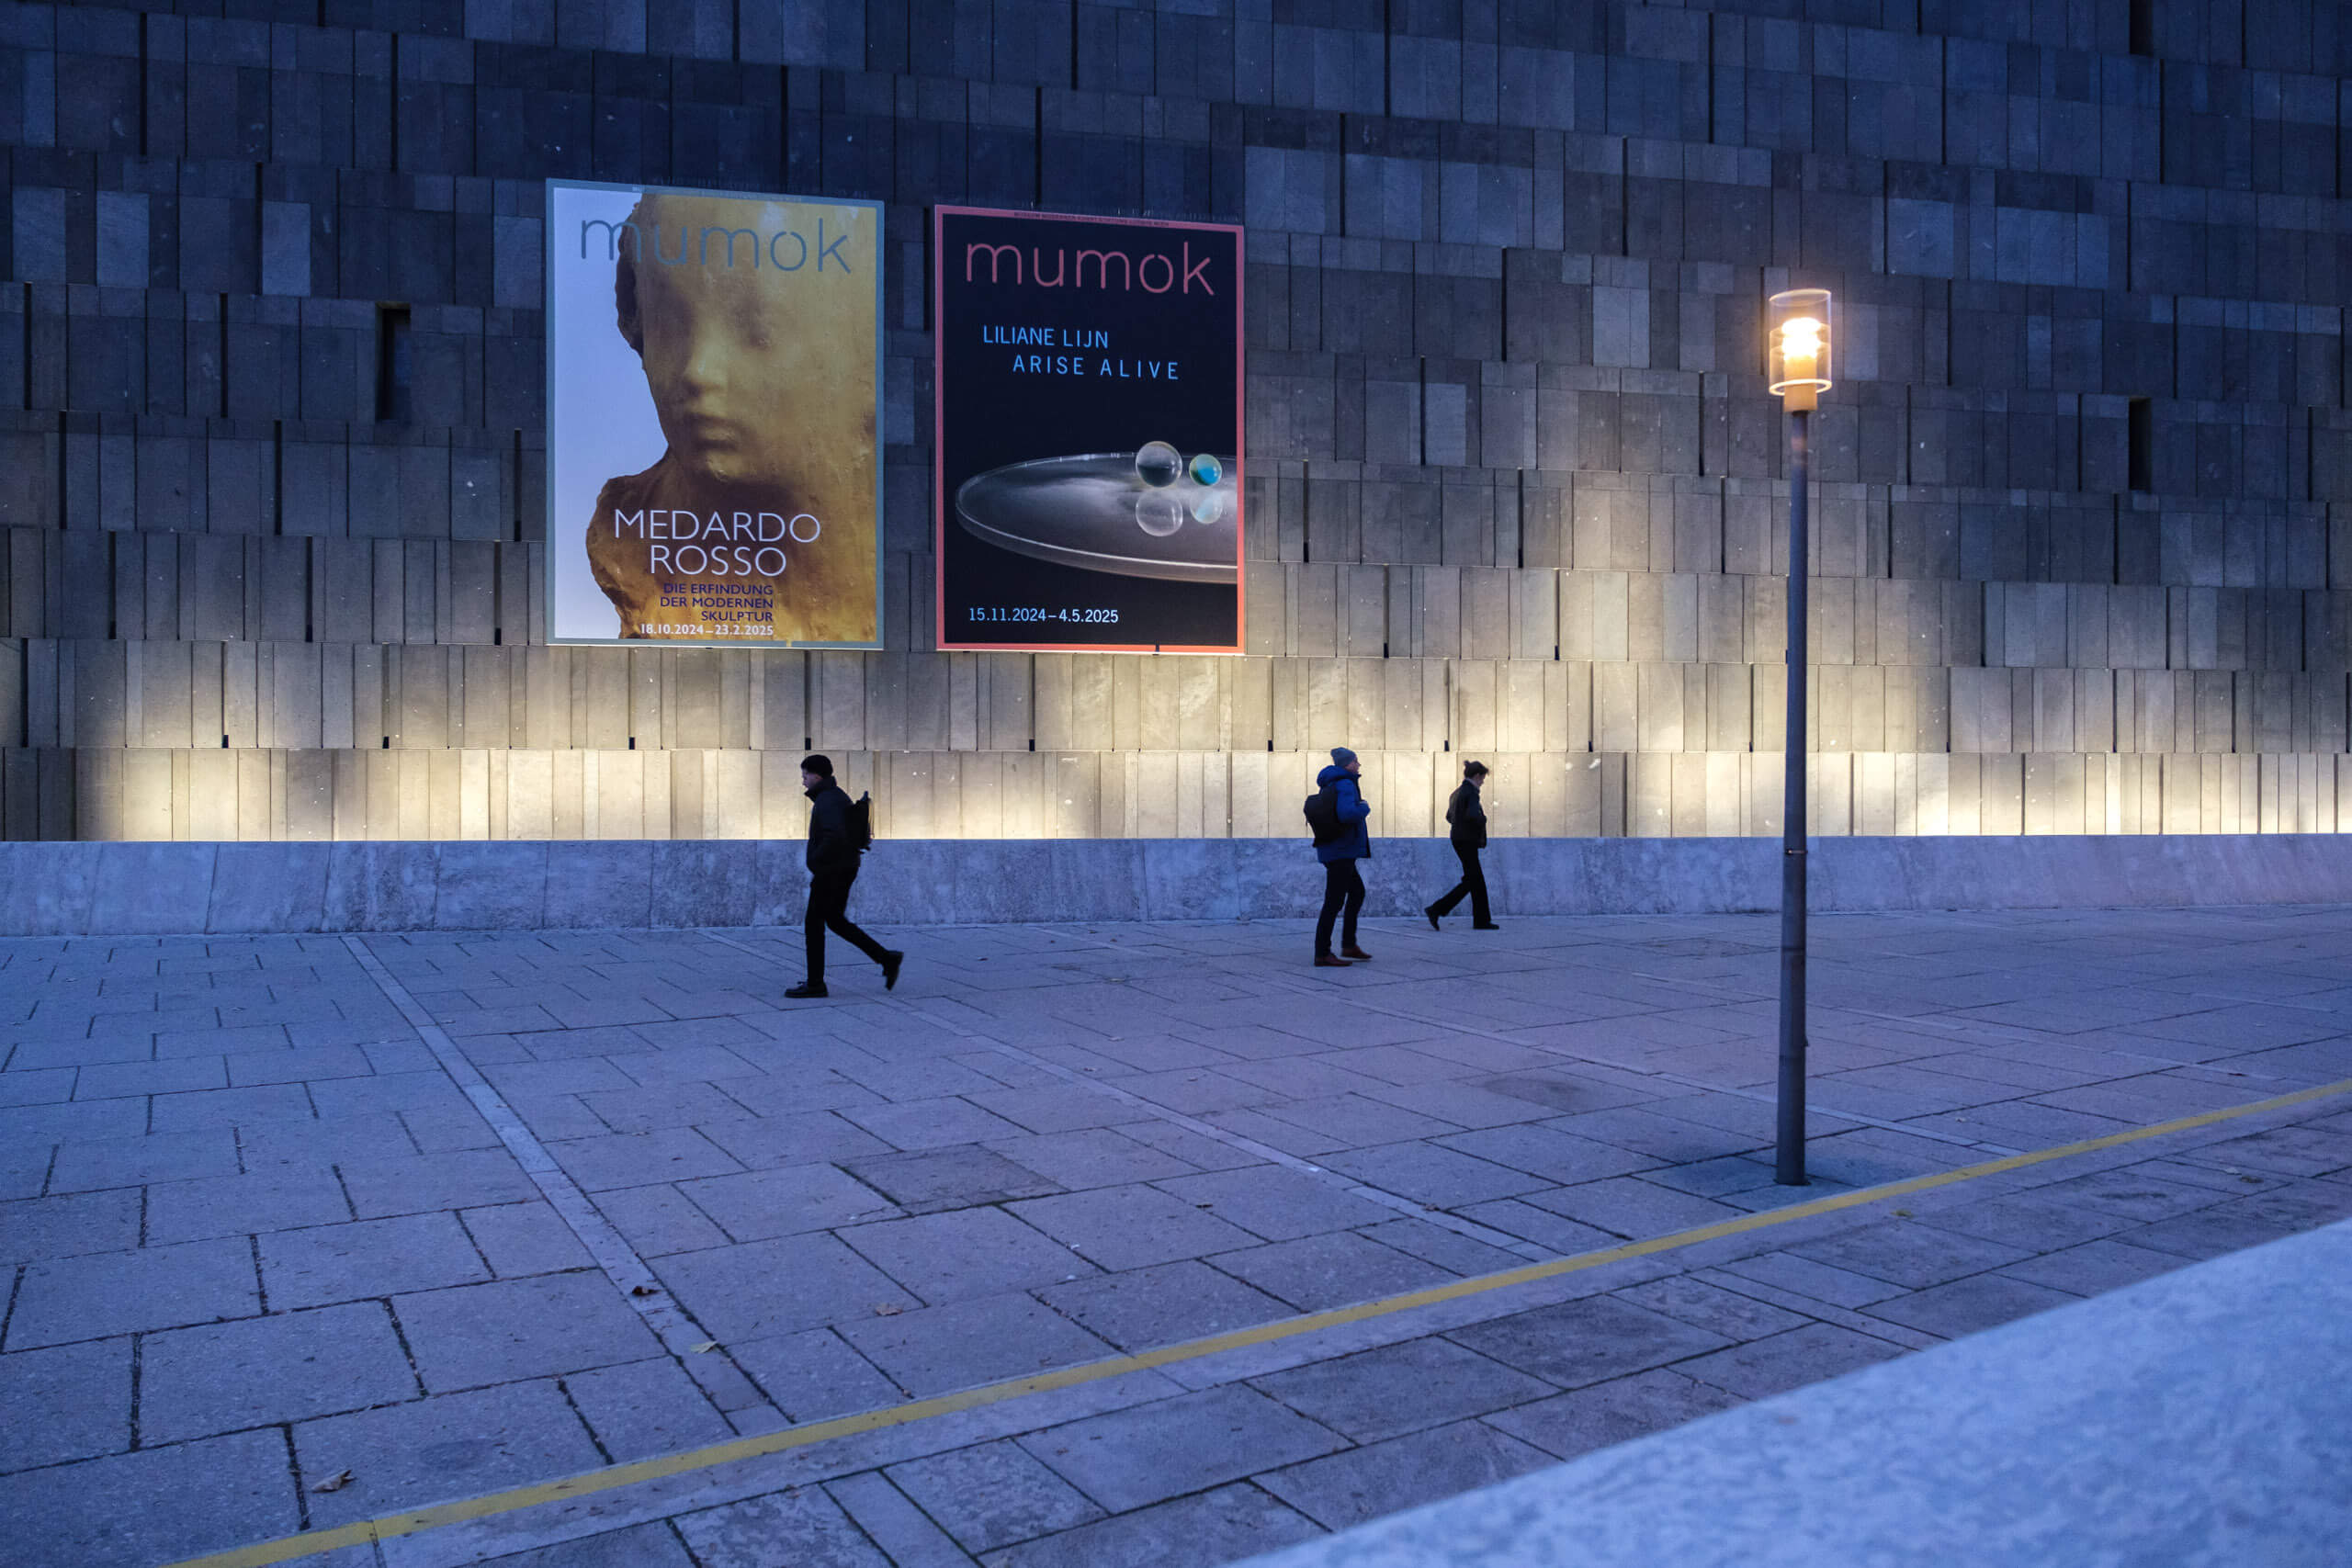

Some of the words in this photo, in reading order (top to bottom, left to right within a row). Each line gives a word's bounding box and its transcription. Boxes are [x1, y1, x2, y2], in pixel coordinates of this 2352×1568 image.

[581, 218, 852, 274] mumok
[966, 241, 1215, 296] mumok
[983, 324, 1056, 346] LILIANE
[1063, 328, 1109, 349] LIJN
[1012, 355, 1084, 376] ARISE
[1100, 358, 1179, 380] ALIVE
[614, 509, 821, 543] MEDARDO
[650, 545, 786, 577] ROSSO
[663, 582, 687, 594] DIE
[690, 583, 774, 595] ERFINDUNG
[660, 596, 687, 607] DER
[692, 597, 774, 609] MODERNEN
[701, 610, 774, 622] SKULPTUR
